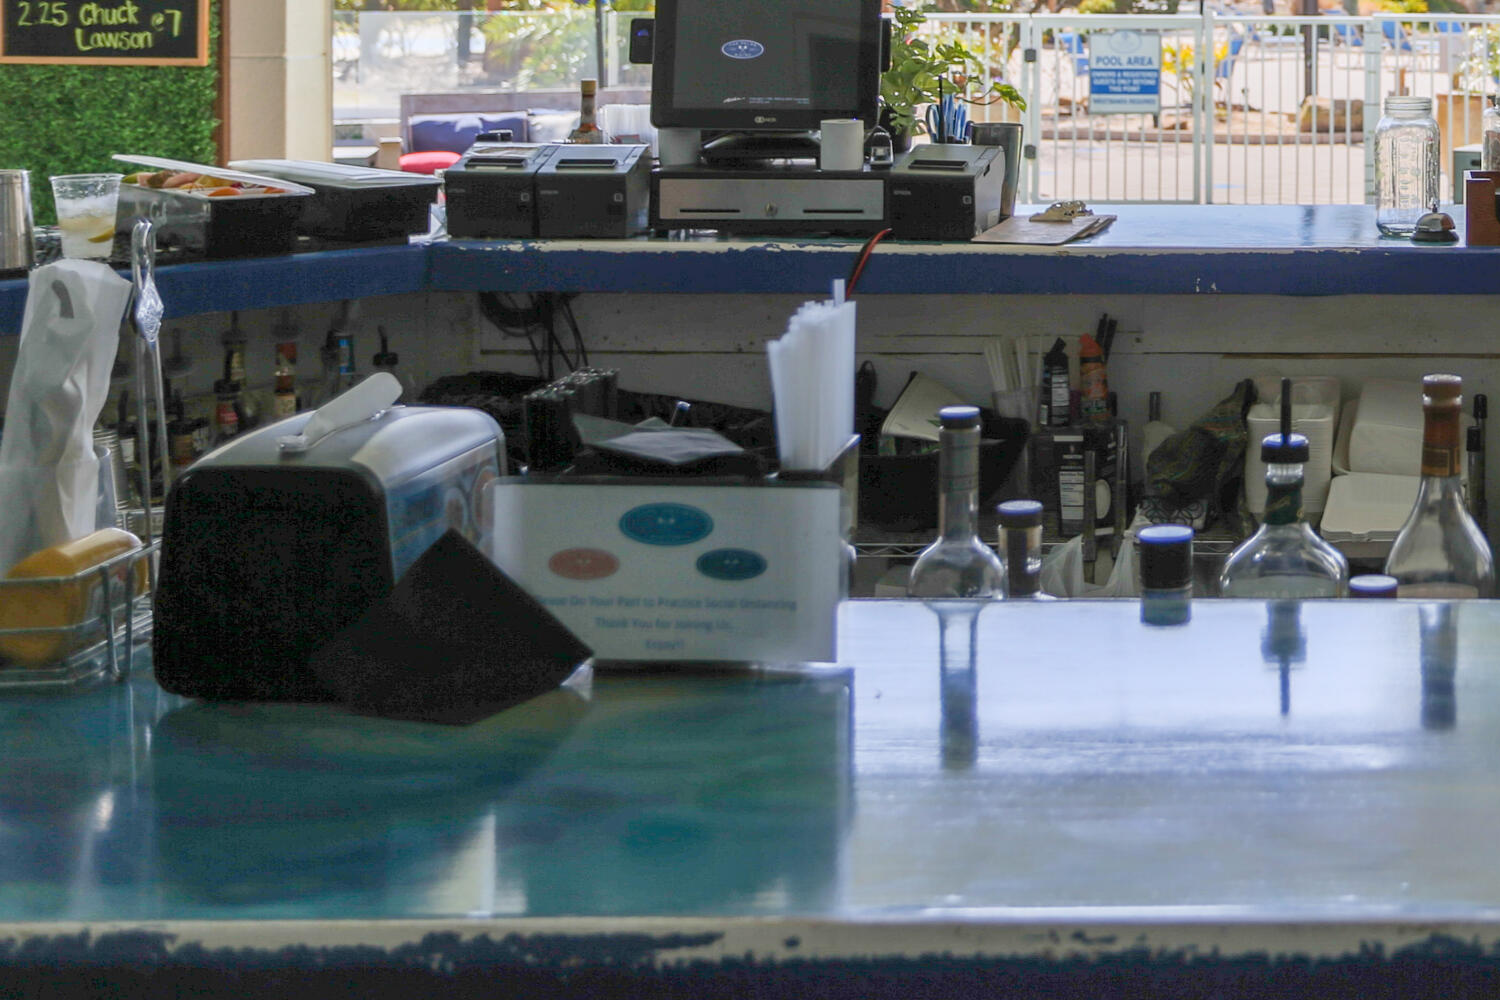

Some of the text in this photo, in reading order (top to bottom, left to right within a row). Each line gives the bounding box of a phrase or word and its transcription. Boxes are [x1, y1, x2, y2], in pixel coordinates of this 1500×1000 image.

[17, 1, 69, 27] 2.25
[78, 0, 140, 26] Chuck
[74, 27, 154, 51] Lawson
[1095, 55, 1154, 67] POOL AREA
